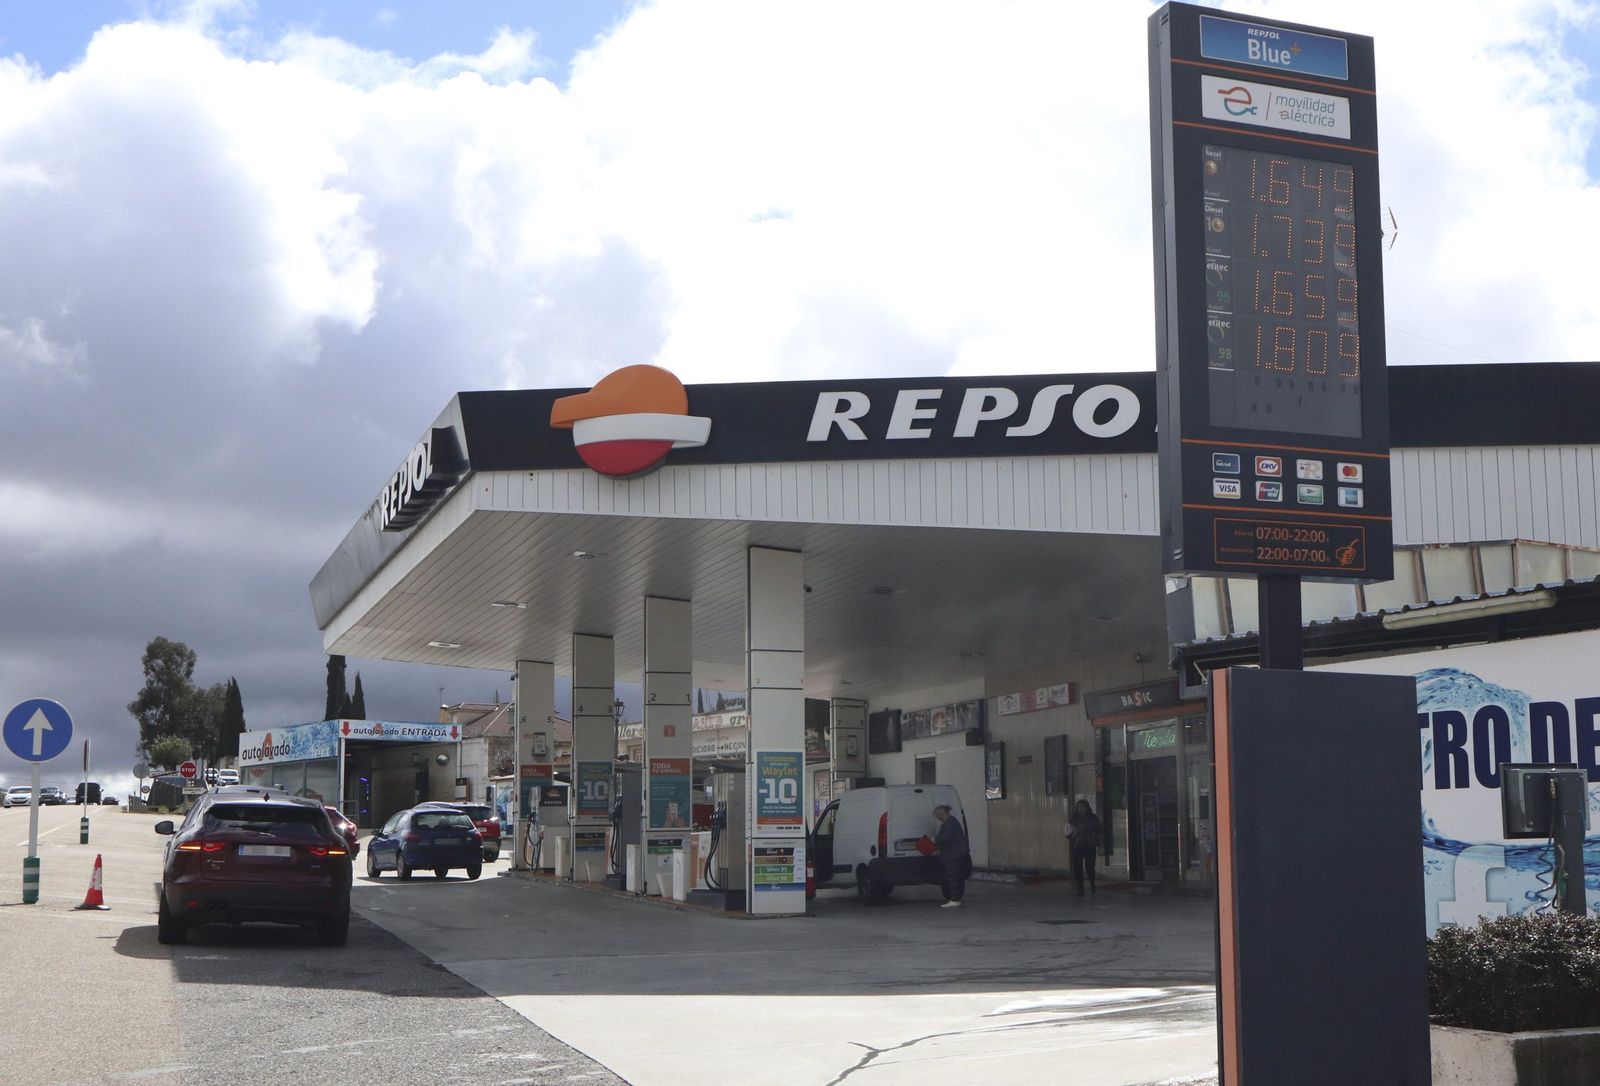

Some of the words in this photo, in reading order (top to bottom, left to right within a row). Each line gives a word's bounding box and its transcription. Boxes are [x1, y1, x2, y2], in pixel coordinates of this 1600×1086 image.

[1248, 28, 1281, 40] REPSOL
[1276, 95, 1335, 114] movilidad
[1279, 110, 1335, 128] eléctrica
[1251, 158, 1355, 212] 1.649
[1205, 205, 1224, 215] Diesel
[1252, 213, 1357, 267] 1.739
[1255, 269, 1359, 323] 1.659
[1218, 347, 1232, 360] 98
[1256, 325, 1360, 378] 1.809
[806, 383, 1158, 442] REPSO
[1261, 462, 1278, 470] DKV
[380, 427, 433, 534] REPSOL
[1218, 484, 1237, 493] VISA
[651, 692, 656, 702] 2
[1121, 691, 1152, 706] BASIC
[578, 705, 583, 713] 4
[607, 705, 613, 714] 3
[353, 727, 399, 736] autolavado
[401, 727, 447, 738] ENTRADA
[1139, 730, 1176, 748] Tienda
[242, 740, 290, 761] autolavado
[762, 766, 798, 778] Waylet
[579, 780, 608, 801] -10
[758, 778, 798, 804] -10
